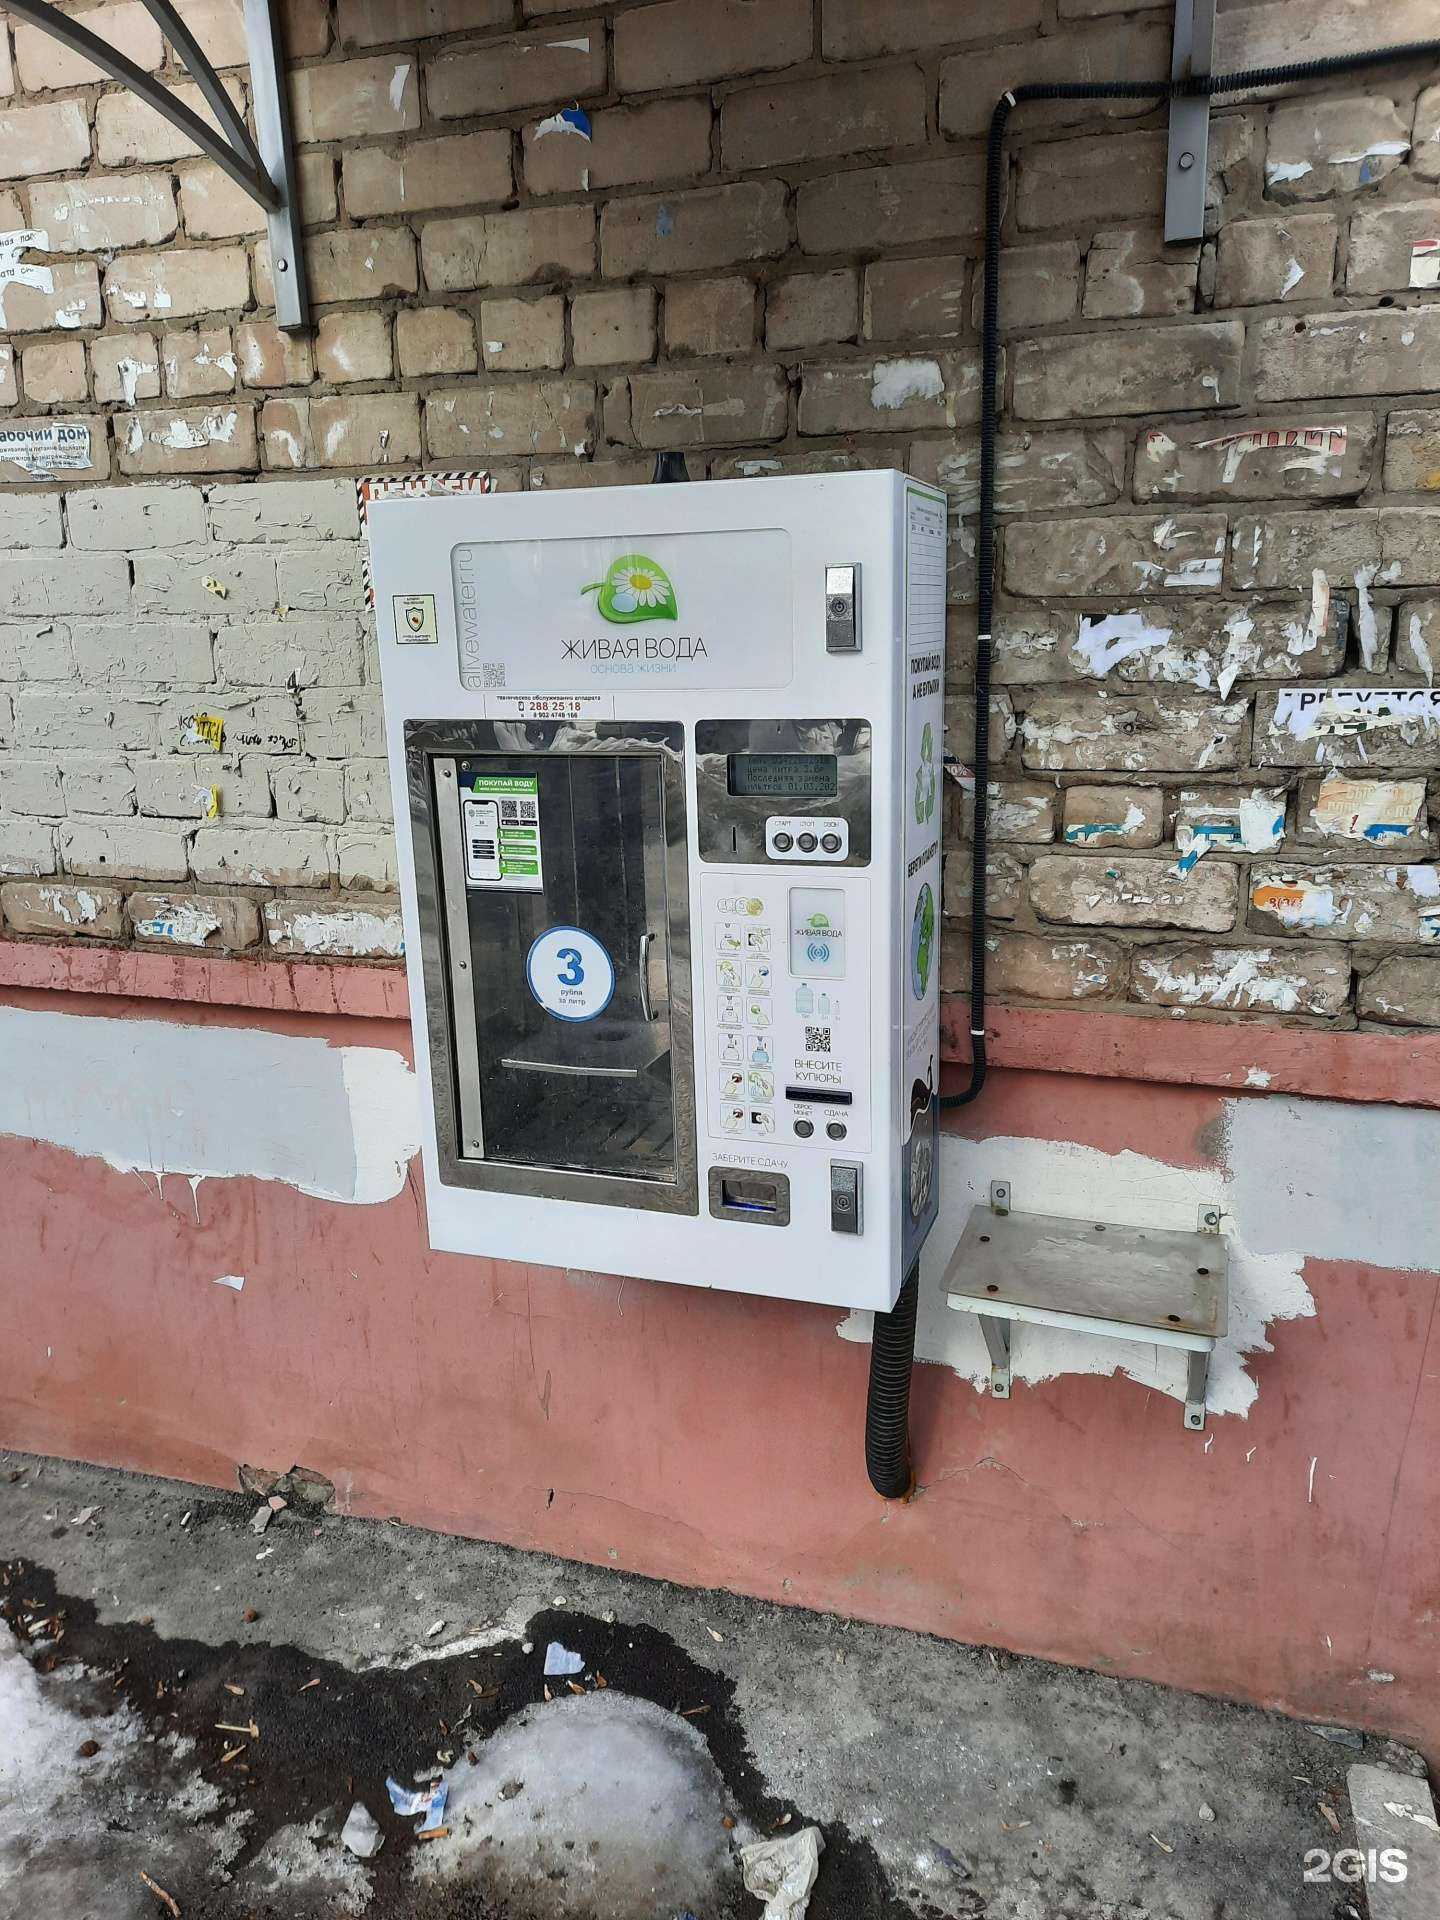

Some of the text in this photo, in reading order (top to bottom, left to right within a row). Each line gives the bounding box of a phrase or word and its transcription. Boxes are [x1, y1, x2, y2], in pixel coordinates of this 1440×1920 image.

[459, 549, 481, 689] alivewater.ru
[561, 637, 708, 662] ЖИВАЯ ВОДА
[590, 664, 677, 674] основа жизни
[529, 701, 581, 711] 288 25 18
[478, 779, 535, 788] ПОКУПАЙ ВОДУ
[794, 929, 843, 938] ЖИВАЯ ВОДА
[556, 947, 584, 986] 3
[794, 1058, 843, 1072] ВНЕСИТЕ
[795, 1071, 842, 1085] КУПЮРЫ
[824, 1109, 849, 1118] СДАЧА
[712, 1152, 788, 1168] ЗАБЕРИТЕ СДАЧУ
